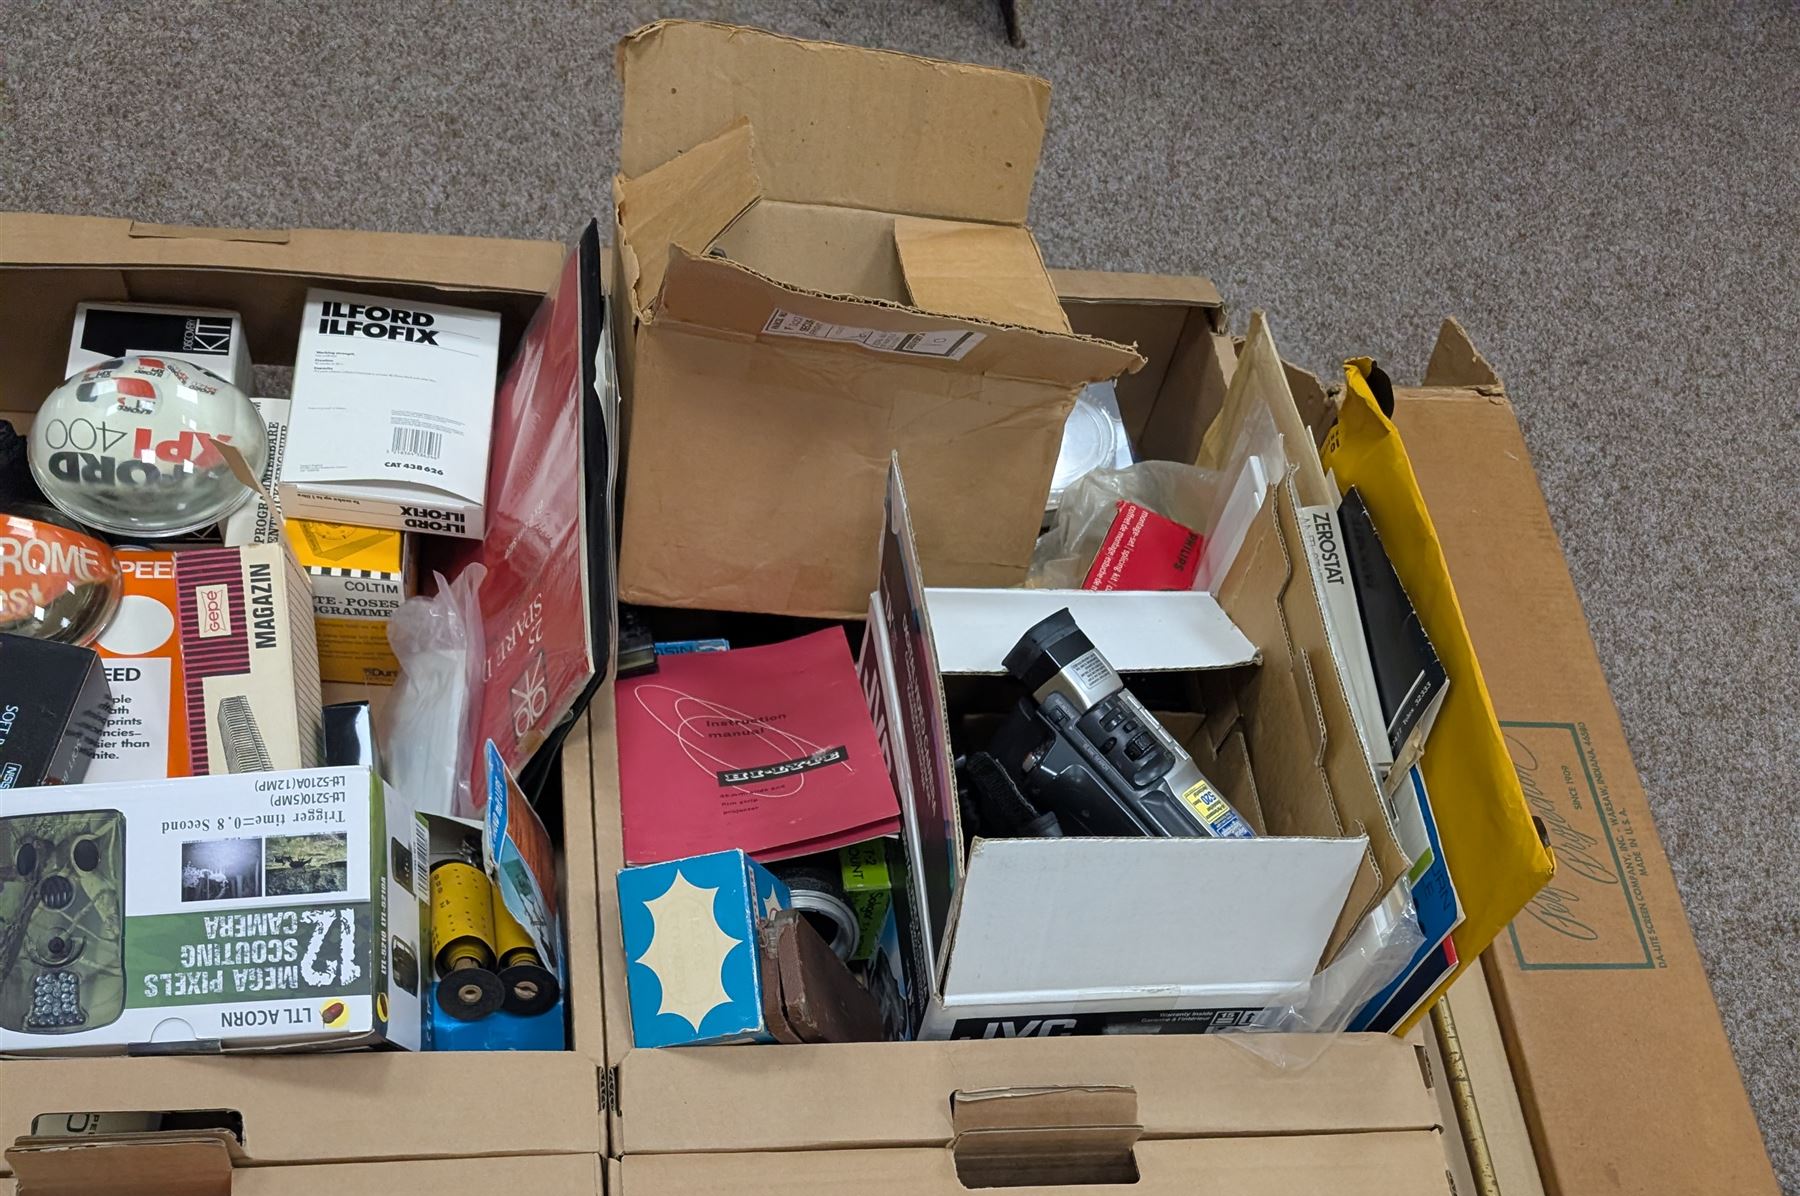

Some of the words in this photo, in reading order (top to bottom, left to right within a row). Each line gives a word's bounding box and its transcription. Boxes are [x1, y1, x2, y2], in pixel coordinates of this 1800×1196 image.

[321, 301, 435, 328] ILFORD
[193, 318, 231, 353] KIT
[318, 318, 440, 347] ILFOFIX
[45, 418, 128, 453] 400
[384, 461, 402, 470] CAT
[400, 505, 465, 523] ILFOFIX
[404, 518, 465, 534] ILFORD
[1173, 531, 1198, 572] PHILIPS
[1312, 512, 1344, 585] ZEROSTAT
[249, 563, 277, 650] MAGAZIN
[348, 598, 399, 609] POSES
[105, 667, 141, 682] EED
[706, 712, 787, 728] Instruction
[708, 727, 765, 739] manual
[92, 750, 120, 760] hite.
[120, 738, 150, 749] than
[1571, 785, 1582, 811] SINCE
[161, 818, 210, 835] Second
[293, 809, 346, 824] Trigger
[849, 849, 864, 880] OUNT
[1636, 852, 1649, 876] MADE
[203, 911, 298, 939] CAMERA
[1641, 901, 1657, 936] SCREEN
[180, 938, 298, 968] SCOUTING
[300, 907, 361, 987] 12
[1650, 935, 1668, 969] DA-LITE
[144, 969, 224, 998] PIXELS
[232, 965, 298, 992] MEGA
[221, 1010, 280, 1027] ACORN
[286, 1007, 311, 1024] LTL
